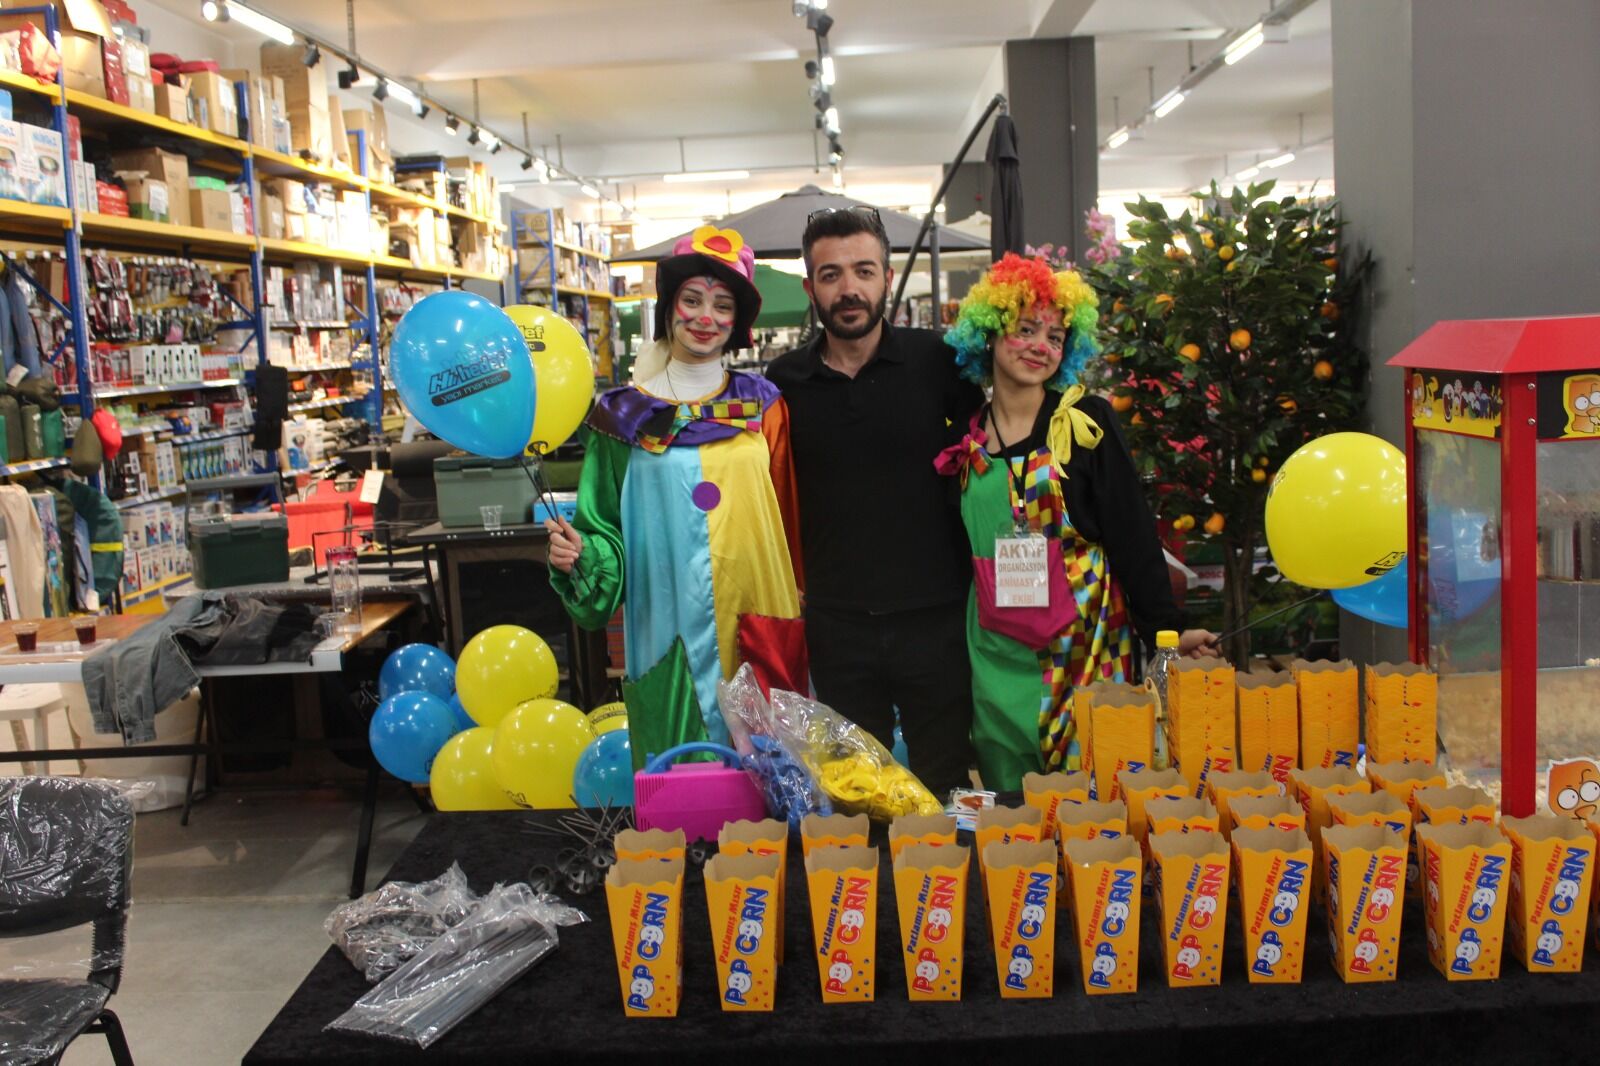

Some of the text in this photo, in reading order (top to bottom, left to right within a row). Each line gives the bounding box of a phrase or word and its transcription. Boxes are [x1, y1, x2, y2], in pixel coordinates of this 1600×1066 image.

[831, 876, 845, 906] Mısır
[918, 874, 932, 904] Mısır
[1013, 869, 1026, 899] Mısır
[1097, 867, 1110, 898] Mısır
[1187, 863, 1201, 893] Mısır
[1268, 856, 1282, 885] Mısır
[1364, 854, 1378, 885] Mısır
[1466, 852, 1480, 882] Mısır
[1548, 844, 1562, 873] Mısır
[631, 889, 642, 919] Mısır
[730, 884, 742, 914] Mısır
[825, 877, 871, 994] POP CORN
[912, 875, 958, 993] POP CORN
[1005, 872, 1052, 991] POP CORN
[1088, 869, 1136, 988] POP CORN
[1172, 864, 1226, 980] POP CORN
[1252, 859, 1308, 976] POP CORN
[1350, 855, 1403, 974] POP CORN
[1451, 854, 1506, 975] POP CORN
[1532, 847, 1589, 967] POP CORN
[628, 892, 669, 1011] POP CORN
[725, 887, 768, 1005] POP CORN
